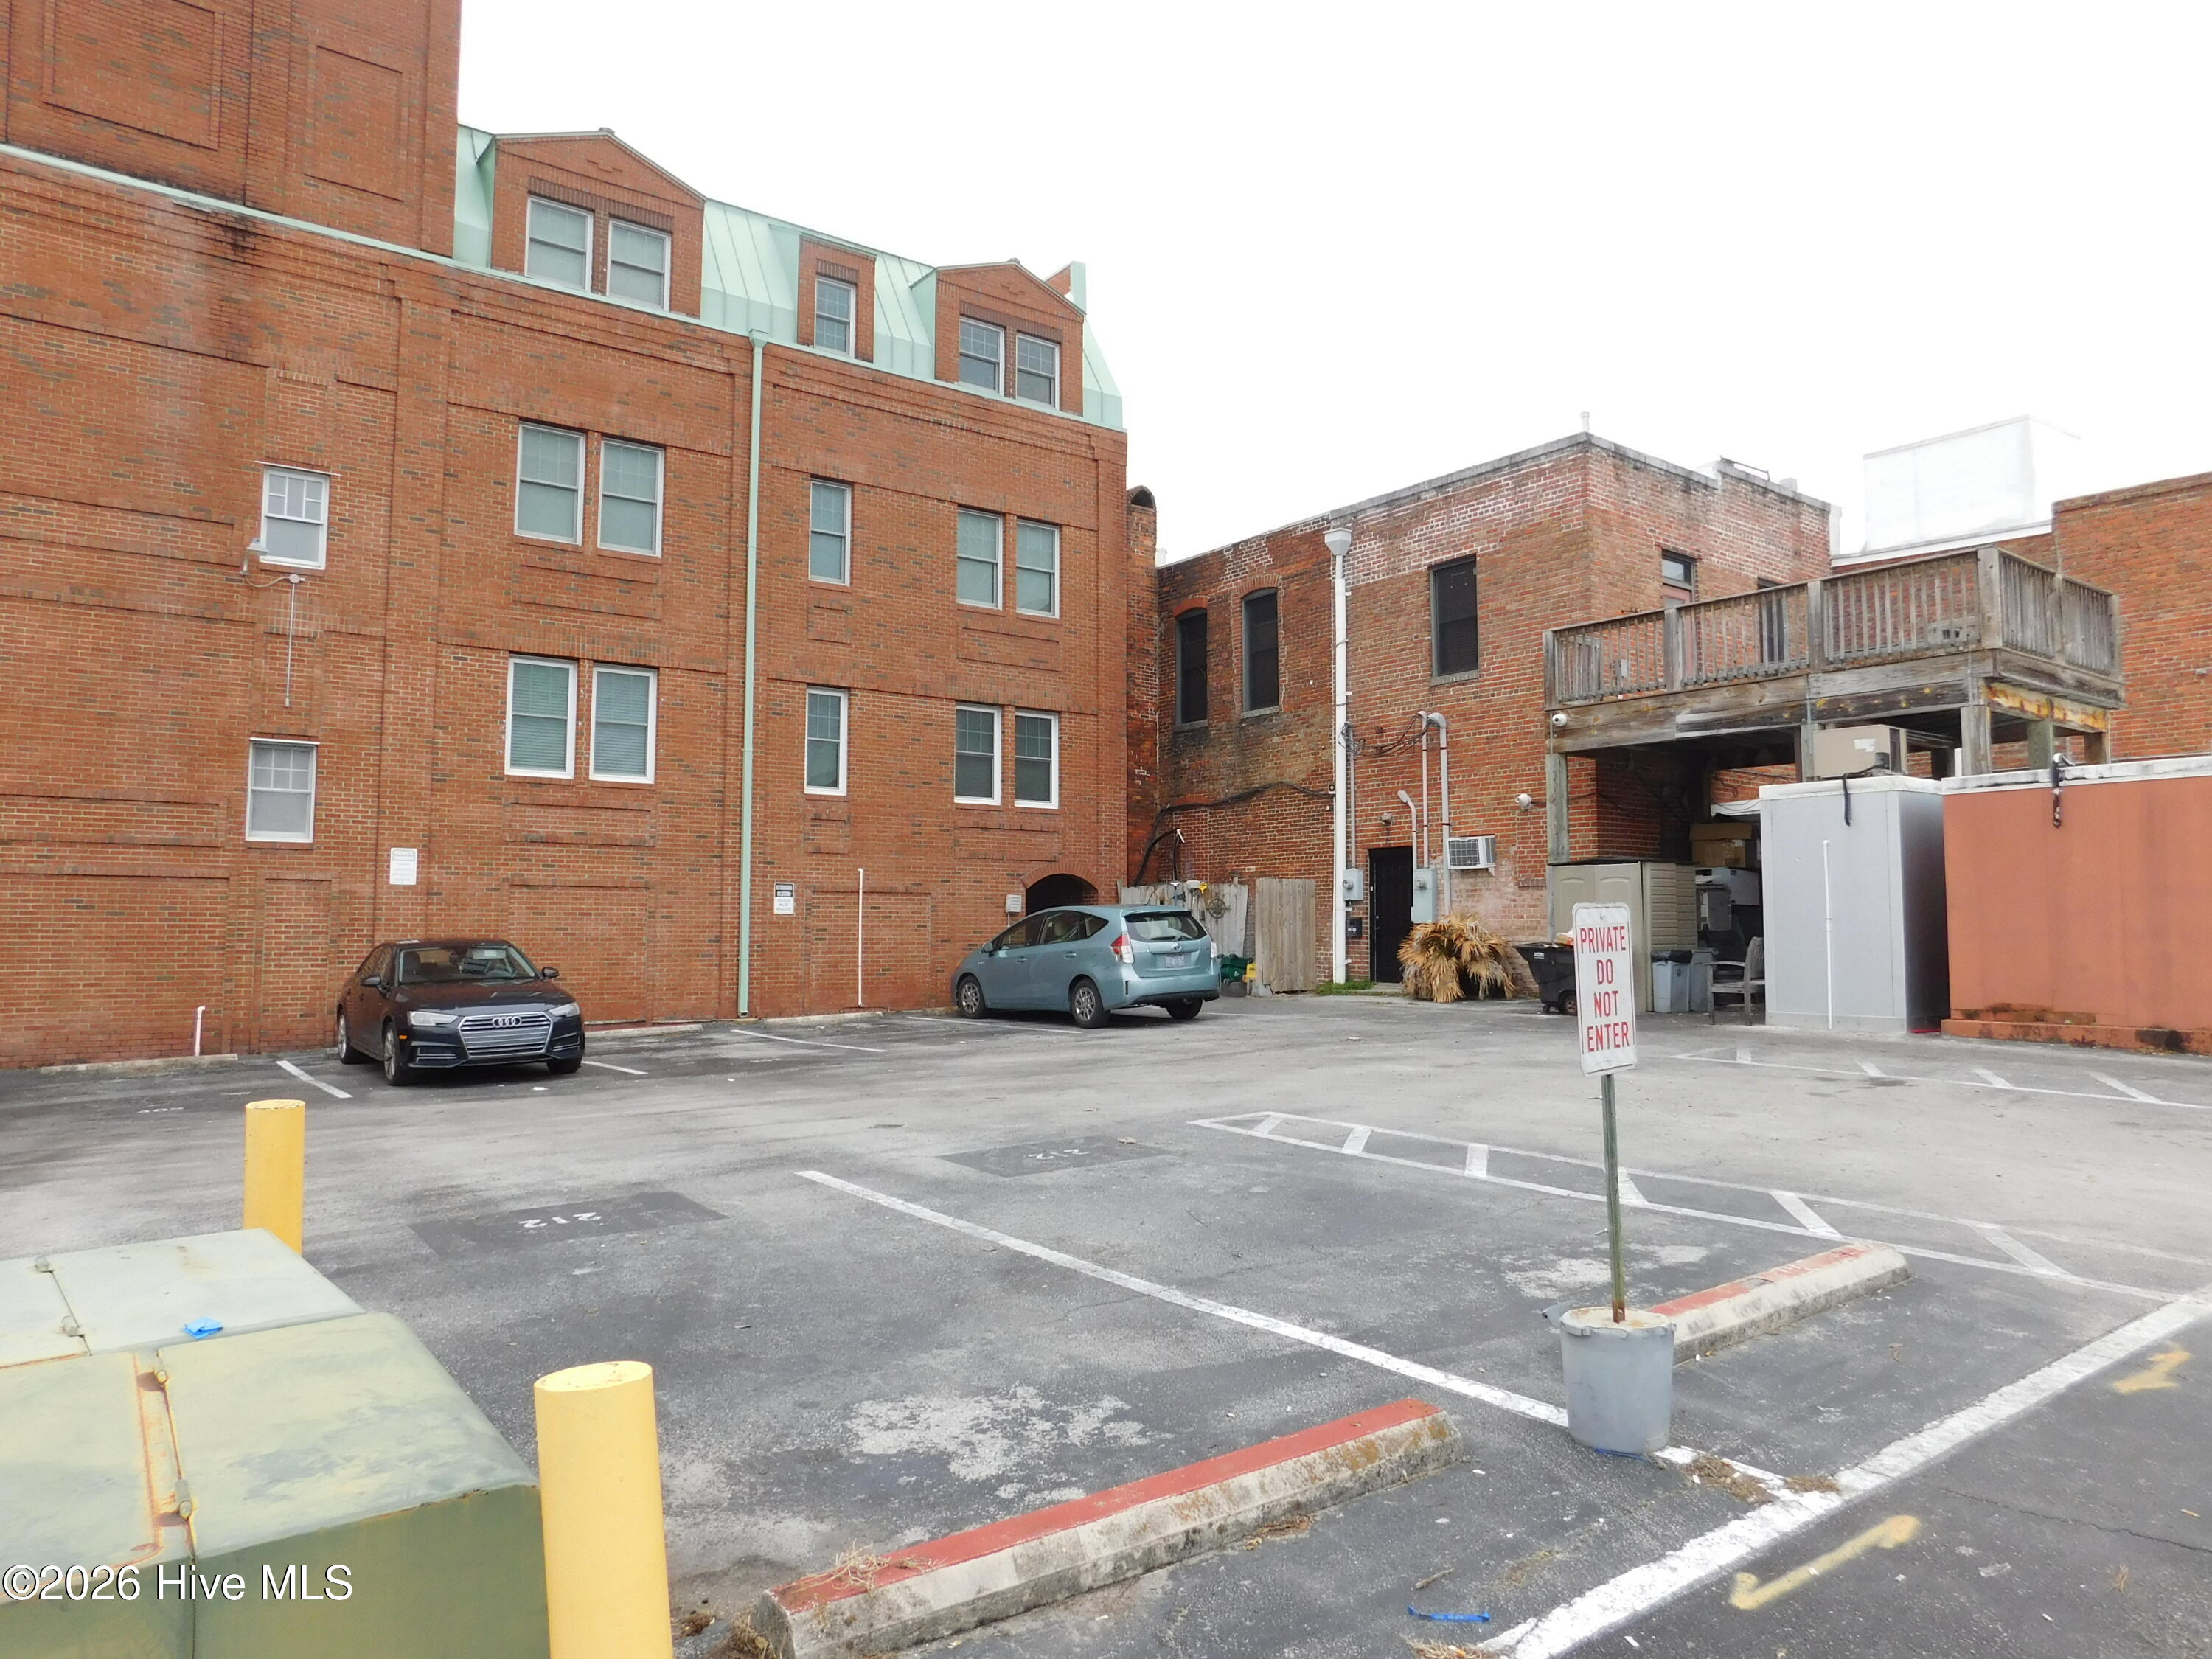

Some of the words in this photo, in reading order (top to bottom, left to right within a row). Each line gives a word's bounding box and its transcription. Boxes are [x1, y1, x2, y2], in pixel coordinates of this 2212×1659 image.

[1579, 925, 1627, 953] PRIVATE
[1596, 959, 1614, 985] DO
[1593, 990, 1619, 1019] NOT
[1587, 1021, 1630, 1053] ENTER
[517, 1211, 602, 1228] 212
